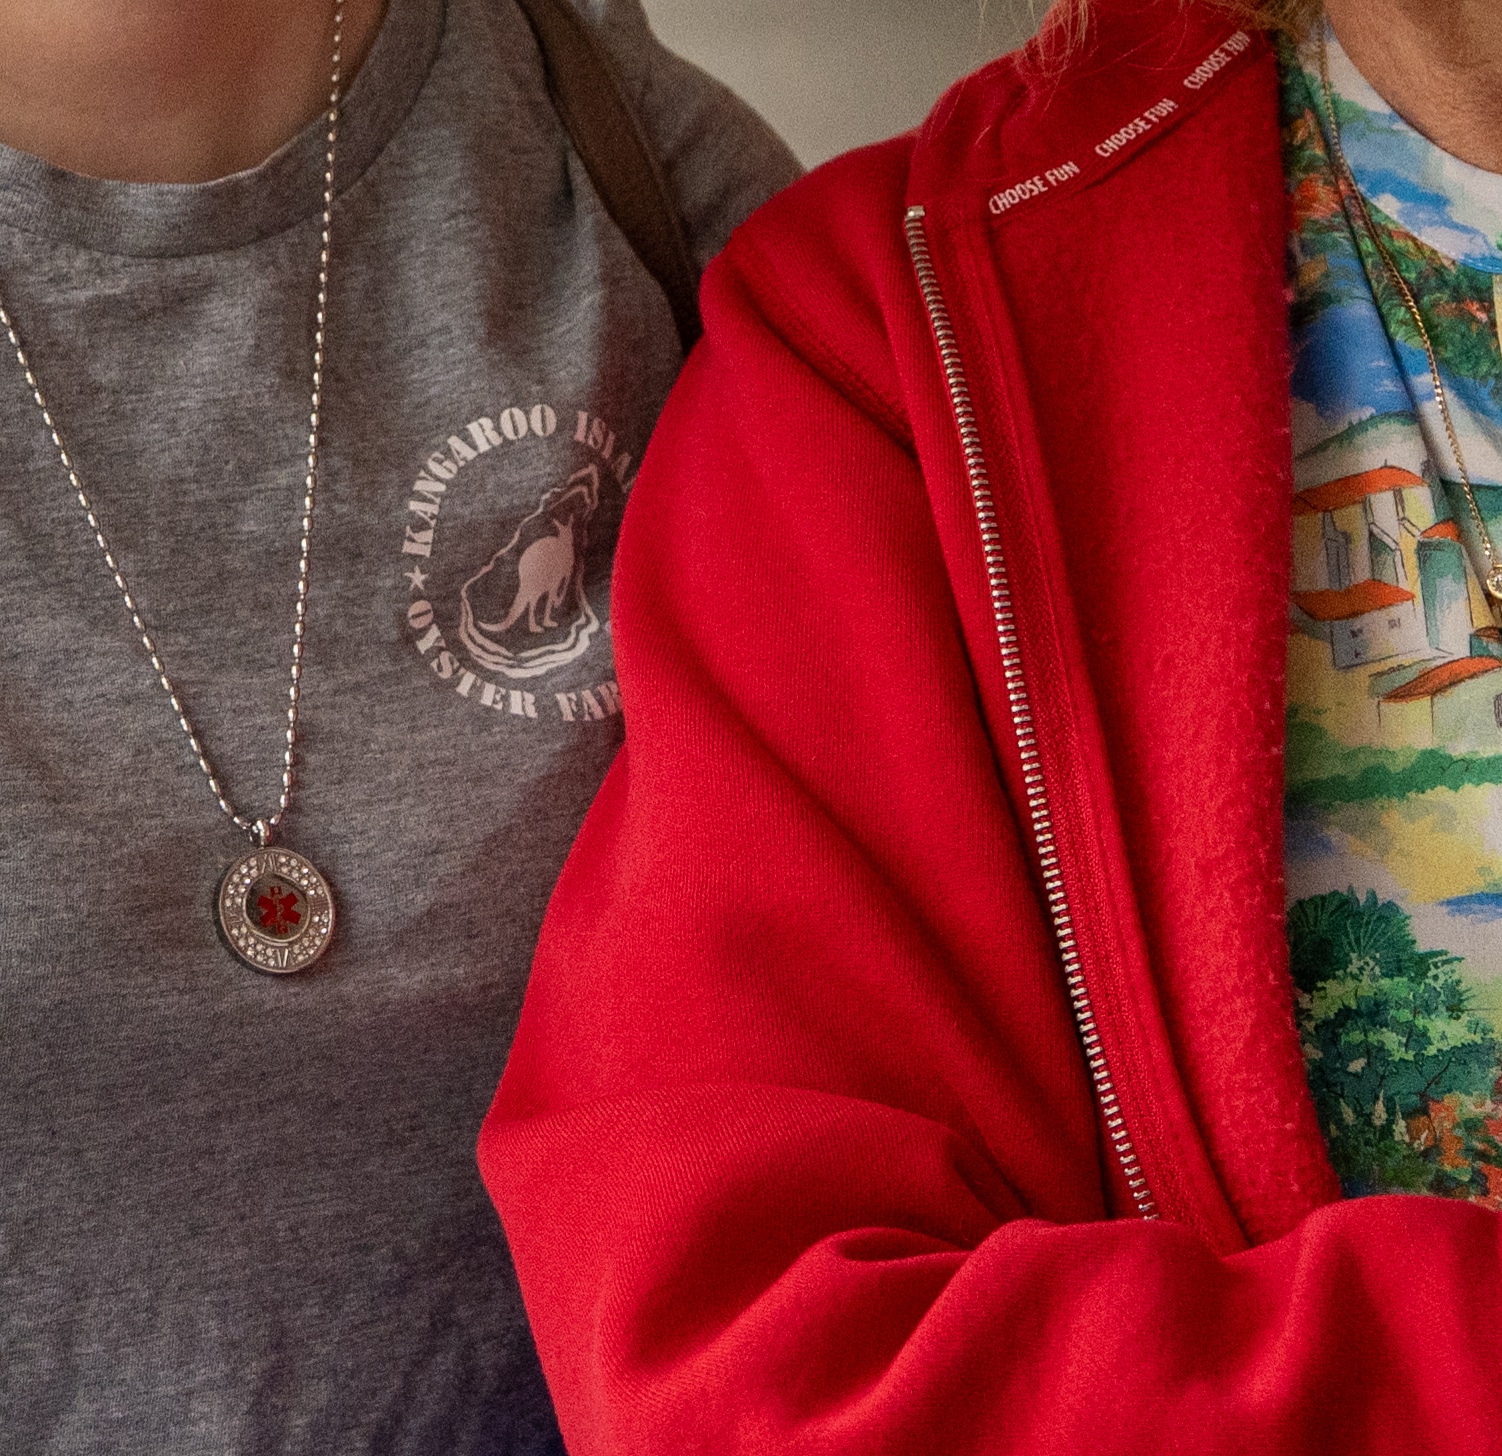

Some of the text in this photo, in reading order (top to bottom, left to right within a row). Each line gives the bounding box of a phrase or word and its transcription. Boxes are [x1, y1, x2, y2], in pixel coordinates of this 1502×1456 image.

[1183, 30, 1251, 89] CHOOSE FUN
[1094, 97, 1179, 158] CHOOSE FUN
[988, 160, 1081, 215] CHOOSE FUN
[401, 403, 558, 558] KANGAROO
[407, 599, 538, 719] OYSTER
